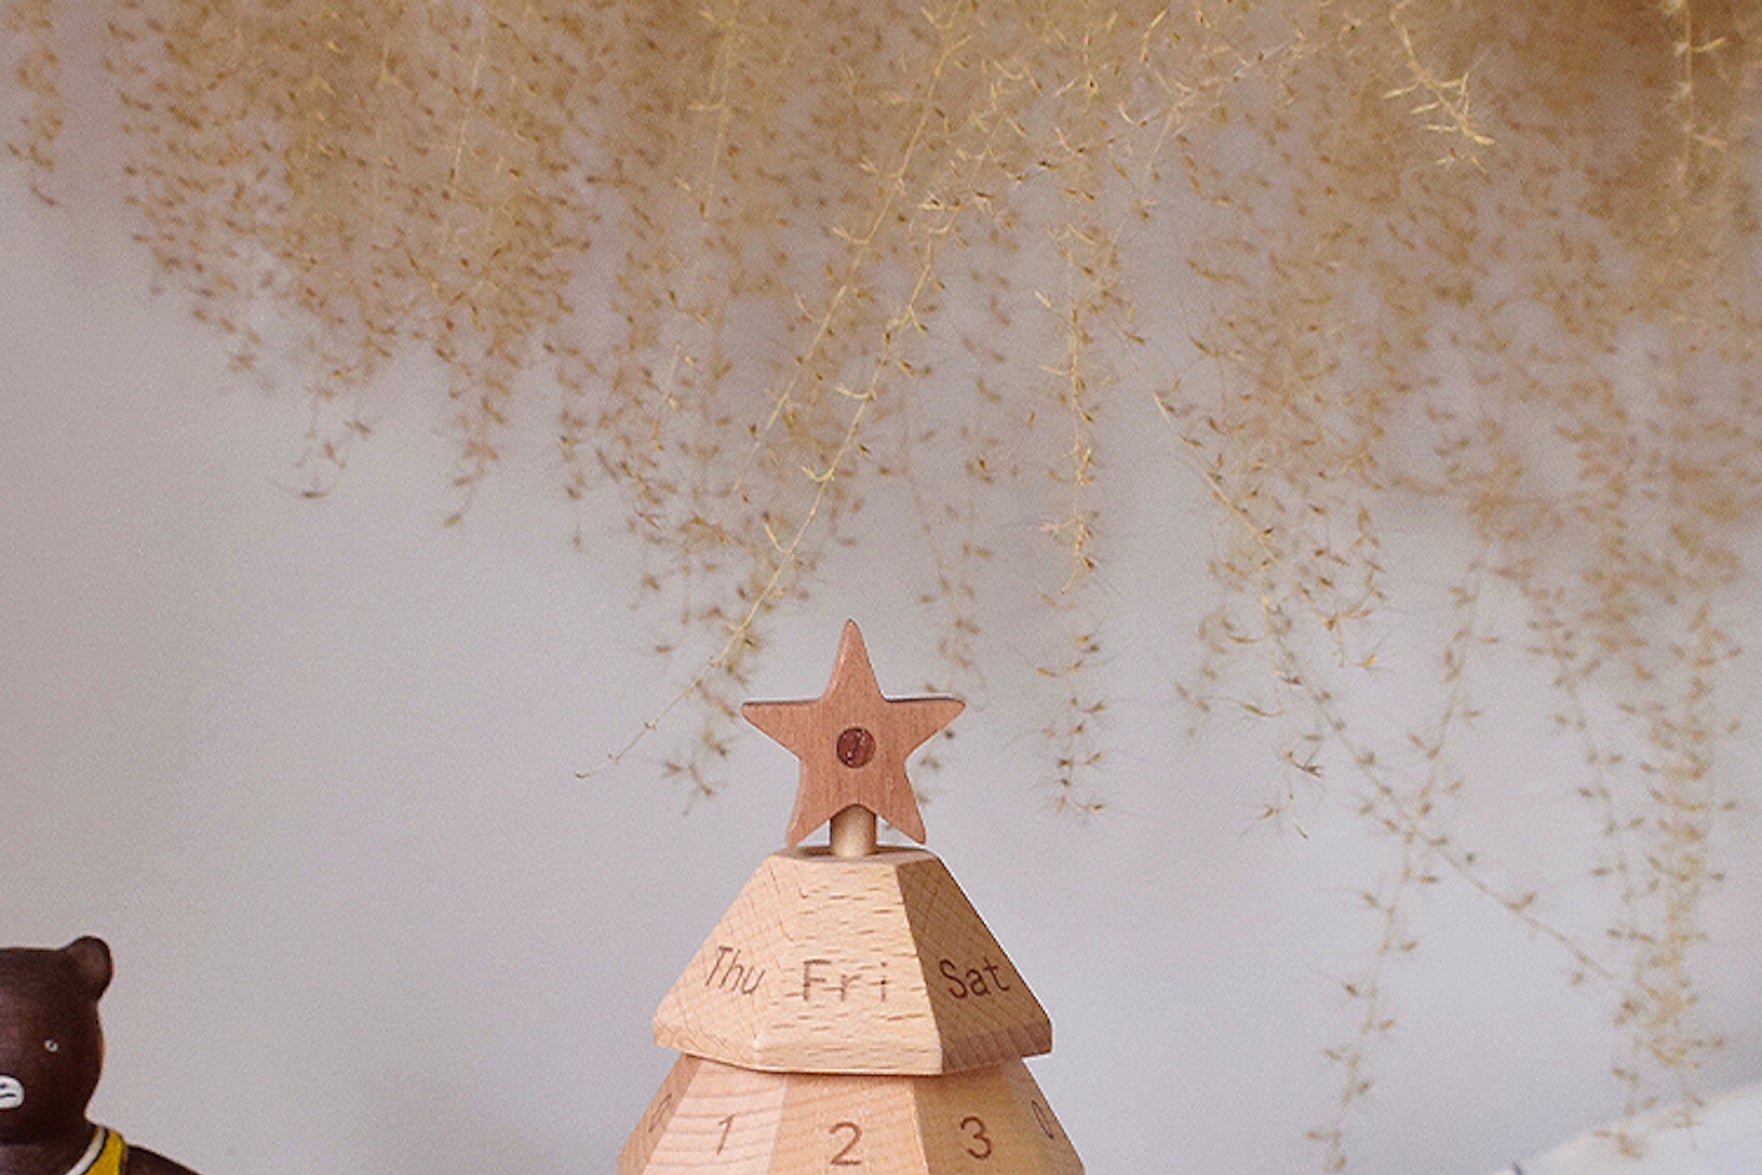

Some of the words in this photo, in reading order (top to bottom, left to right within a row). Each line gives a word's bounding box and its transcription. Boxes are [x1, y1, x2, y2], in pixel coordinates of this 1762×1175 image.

[705, 945, 767, 997] Thu
[802, 958, 889, 1001] Fri
[938, 955, 1011, 999] Sat
[717, 1114, 735, 1156] 1
[827, 1121, 863, 1166] 2
[959, 1116, 993, 1160] 3
